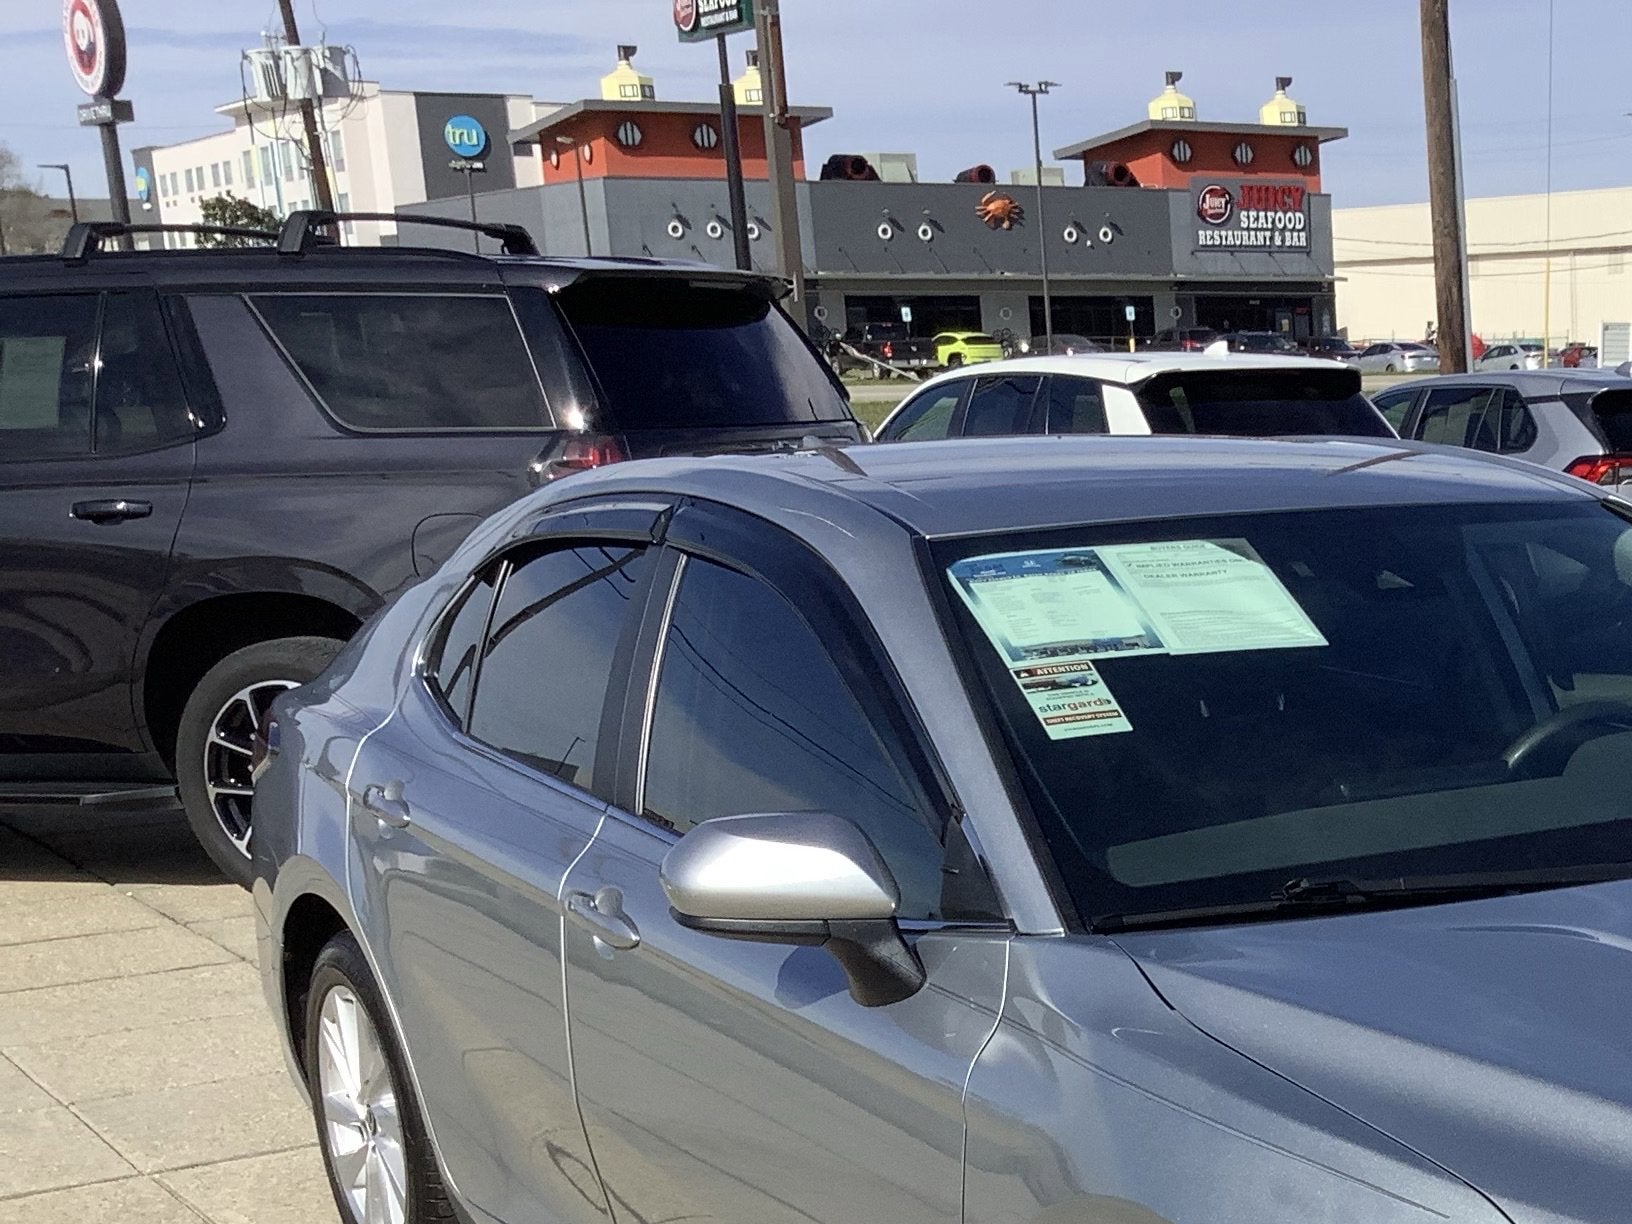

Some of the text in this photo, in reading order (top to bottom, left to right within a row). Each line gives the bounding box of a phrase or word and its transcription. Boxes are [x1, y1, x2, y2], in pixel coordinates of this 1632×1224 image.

[446, 124, 478, 145] tru
[1237, 185, 1304, 208] JUICY
[1240, 211, 1304, 229] SEAFOOD
[1198, 230, 1306, 246] RESTAURANT & BAR
[1036, 664, 1089, 676] ATTENTION
